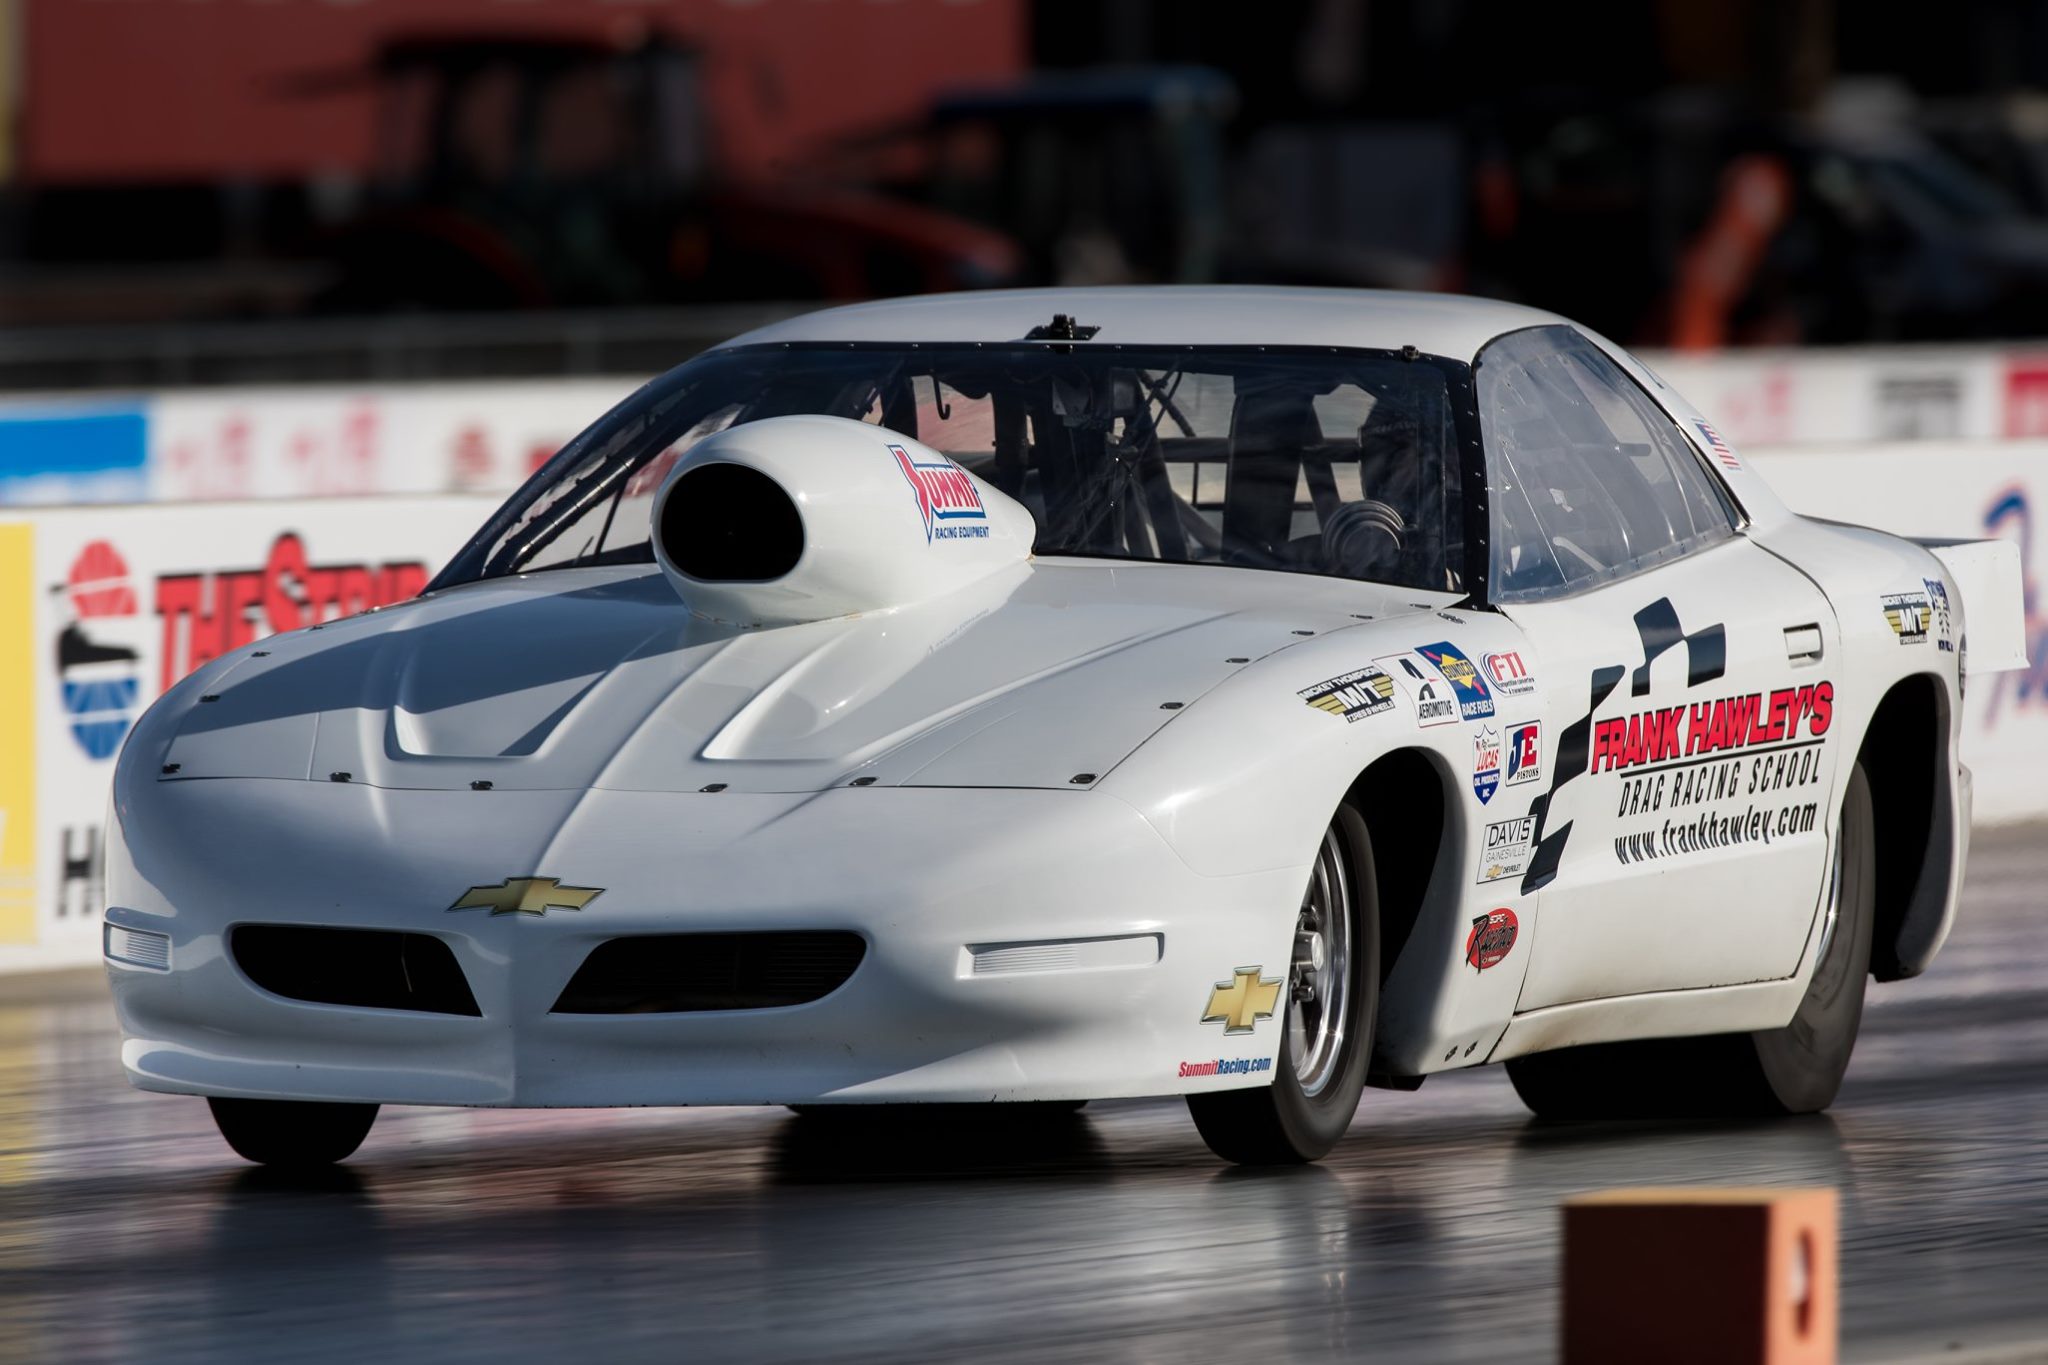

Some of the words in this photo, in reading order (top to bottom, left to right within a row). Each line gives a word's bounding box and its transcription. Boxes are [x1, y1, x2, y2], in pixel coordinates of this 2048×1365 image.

[934, 526, 958, 540] RACING
[958, 525, 990, 539] EQUIPMENT
[1441, 661, 1475, 679] SUNOCO
[1488, 651, 1527, 682] FTI
[1299, 680, 1336, 699] MICKEY
[1332, 667, 1382, 687] THOMPSON
[1331, 680, 1384, 710] M/T
[1418, 700, 1453, 720] AEROMOTIVE
[1462, 702, 1478, 717] RACE
[1477, 700, 1494, 714] FUELS
[1591, 703, 1687, 776] FRANK
[1684, 680, 1834, 757] HAWLEY'S
[1476, 748, 1499, 772] LUCAS
[1507, 725, 1538, 781] JE
[1516, 767, 1539, 781] PISTONS
[1617, 774, 1666, 818] DRAG
[1670, 760, 1742, 808] RACING
[1748, 748, 1822, 795] SCHOOL
[1488, 818, 1532, 848] DAVIS
[1614, 801, 1819, 866] www.frankhawley.com
[1485, 845, 1528, 863] GAINESVILLE
[1178, 1057, 1272, 1079] SummitRacing.com
